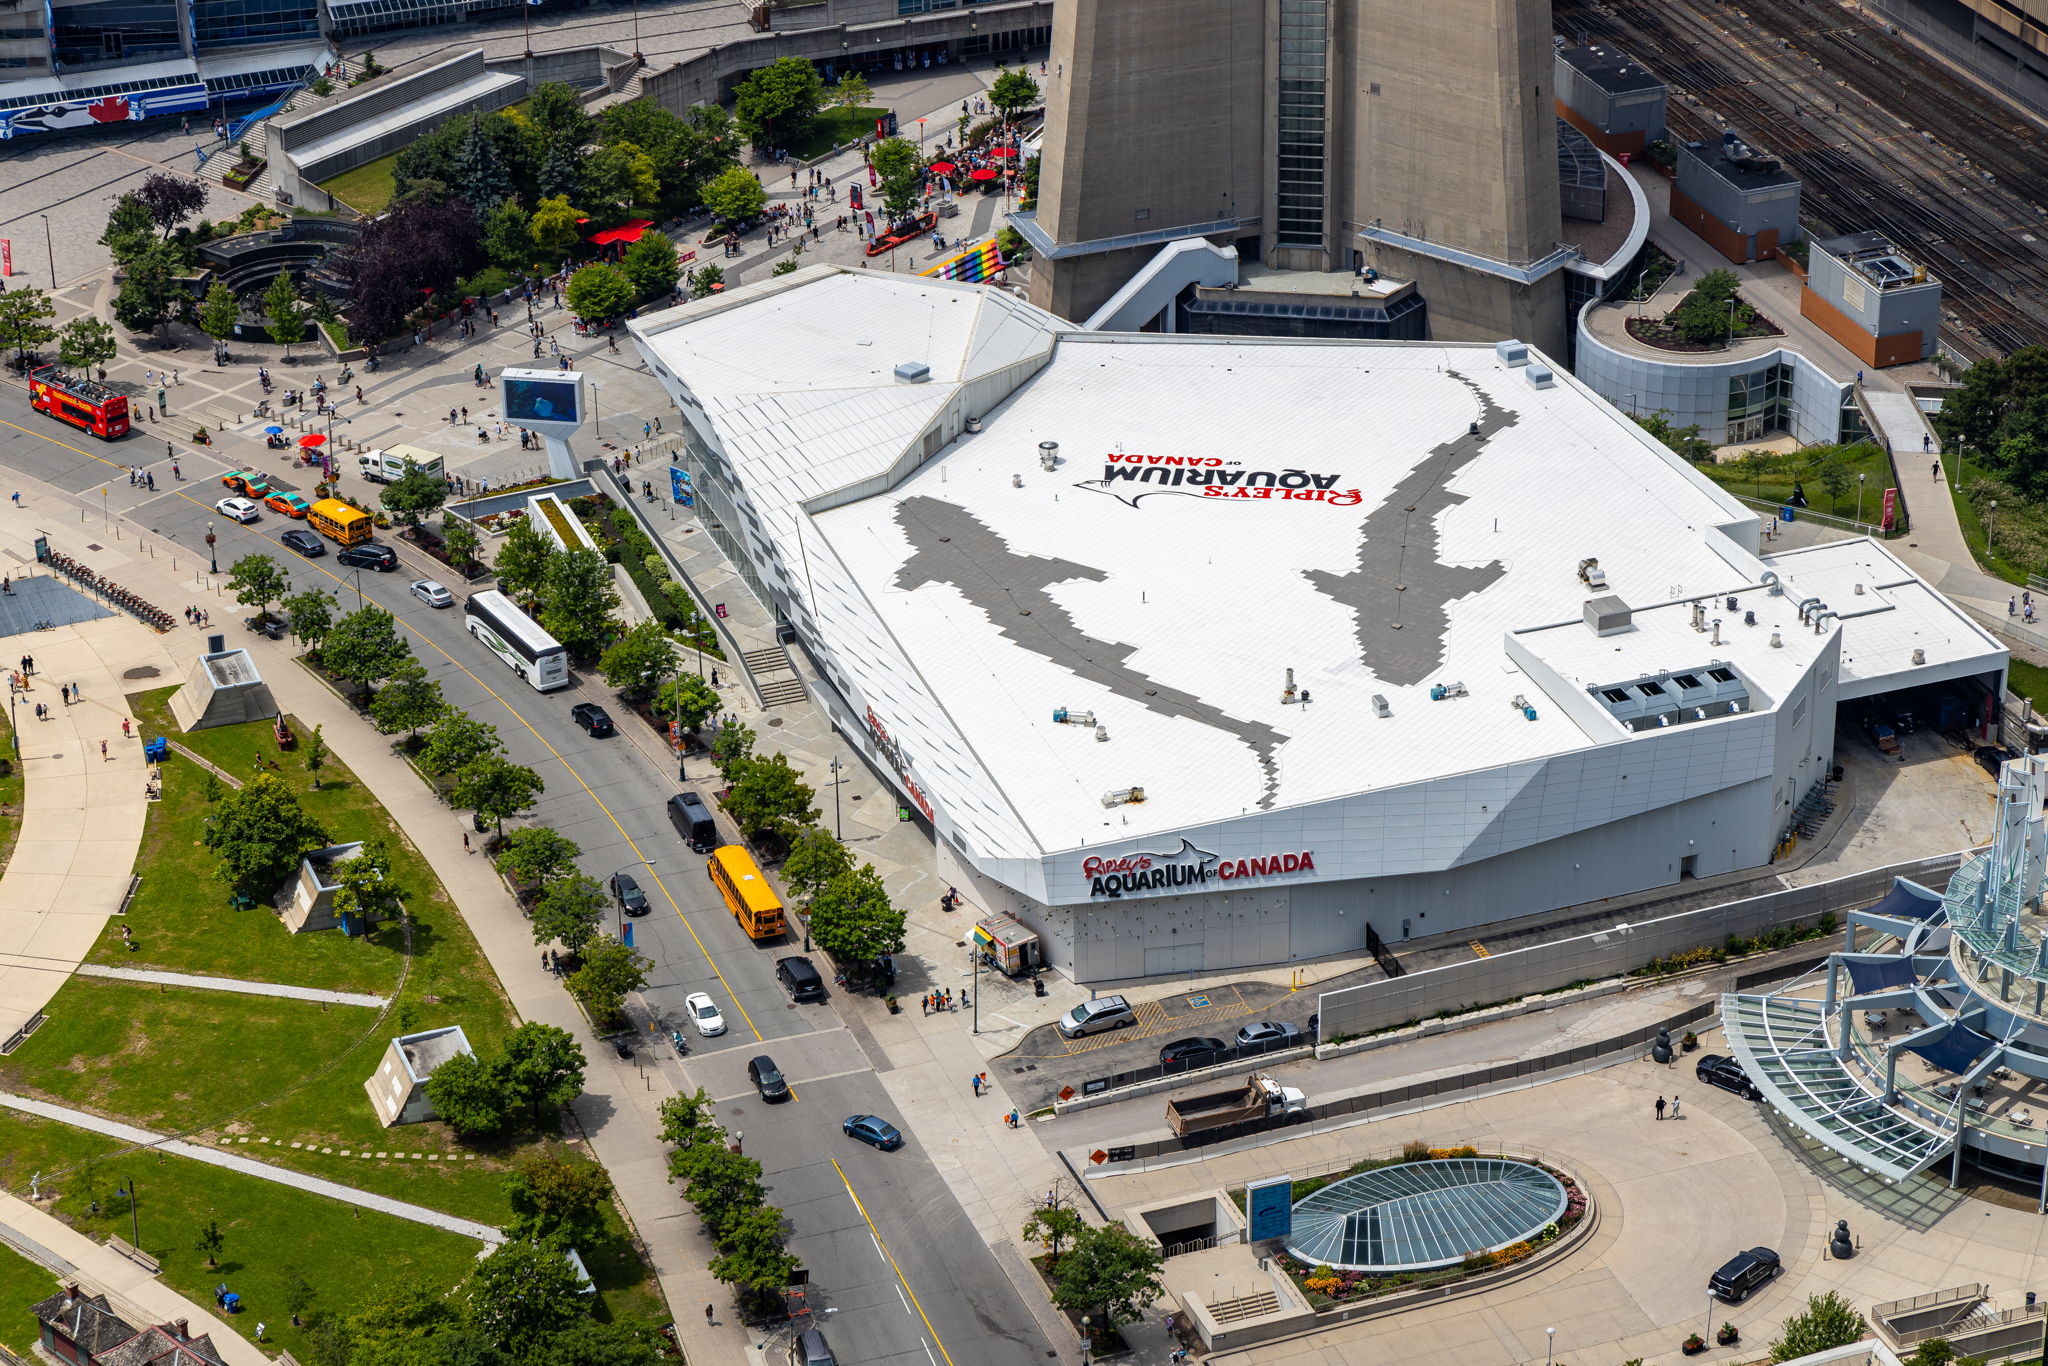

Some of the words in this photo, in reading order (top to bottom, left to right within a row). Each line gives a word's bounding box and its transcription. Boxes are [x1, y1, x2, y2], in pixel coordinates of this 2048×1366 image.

[1107, 454, 1223, 467] CANADA
[1104, 465, 1341, 489] AQUARIUM
[1090, 862, 1207, 898] AQUARIUM
[1218, 851, 1315, 881] CANADA
